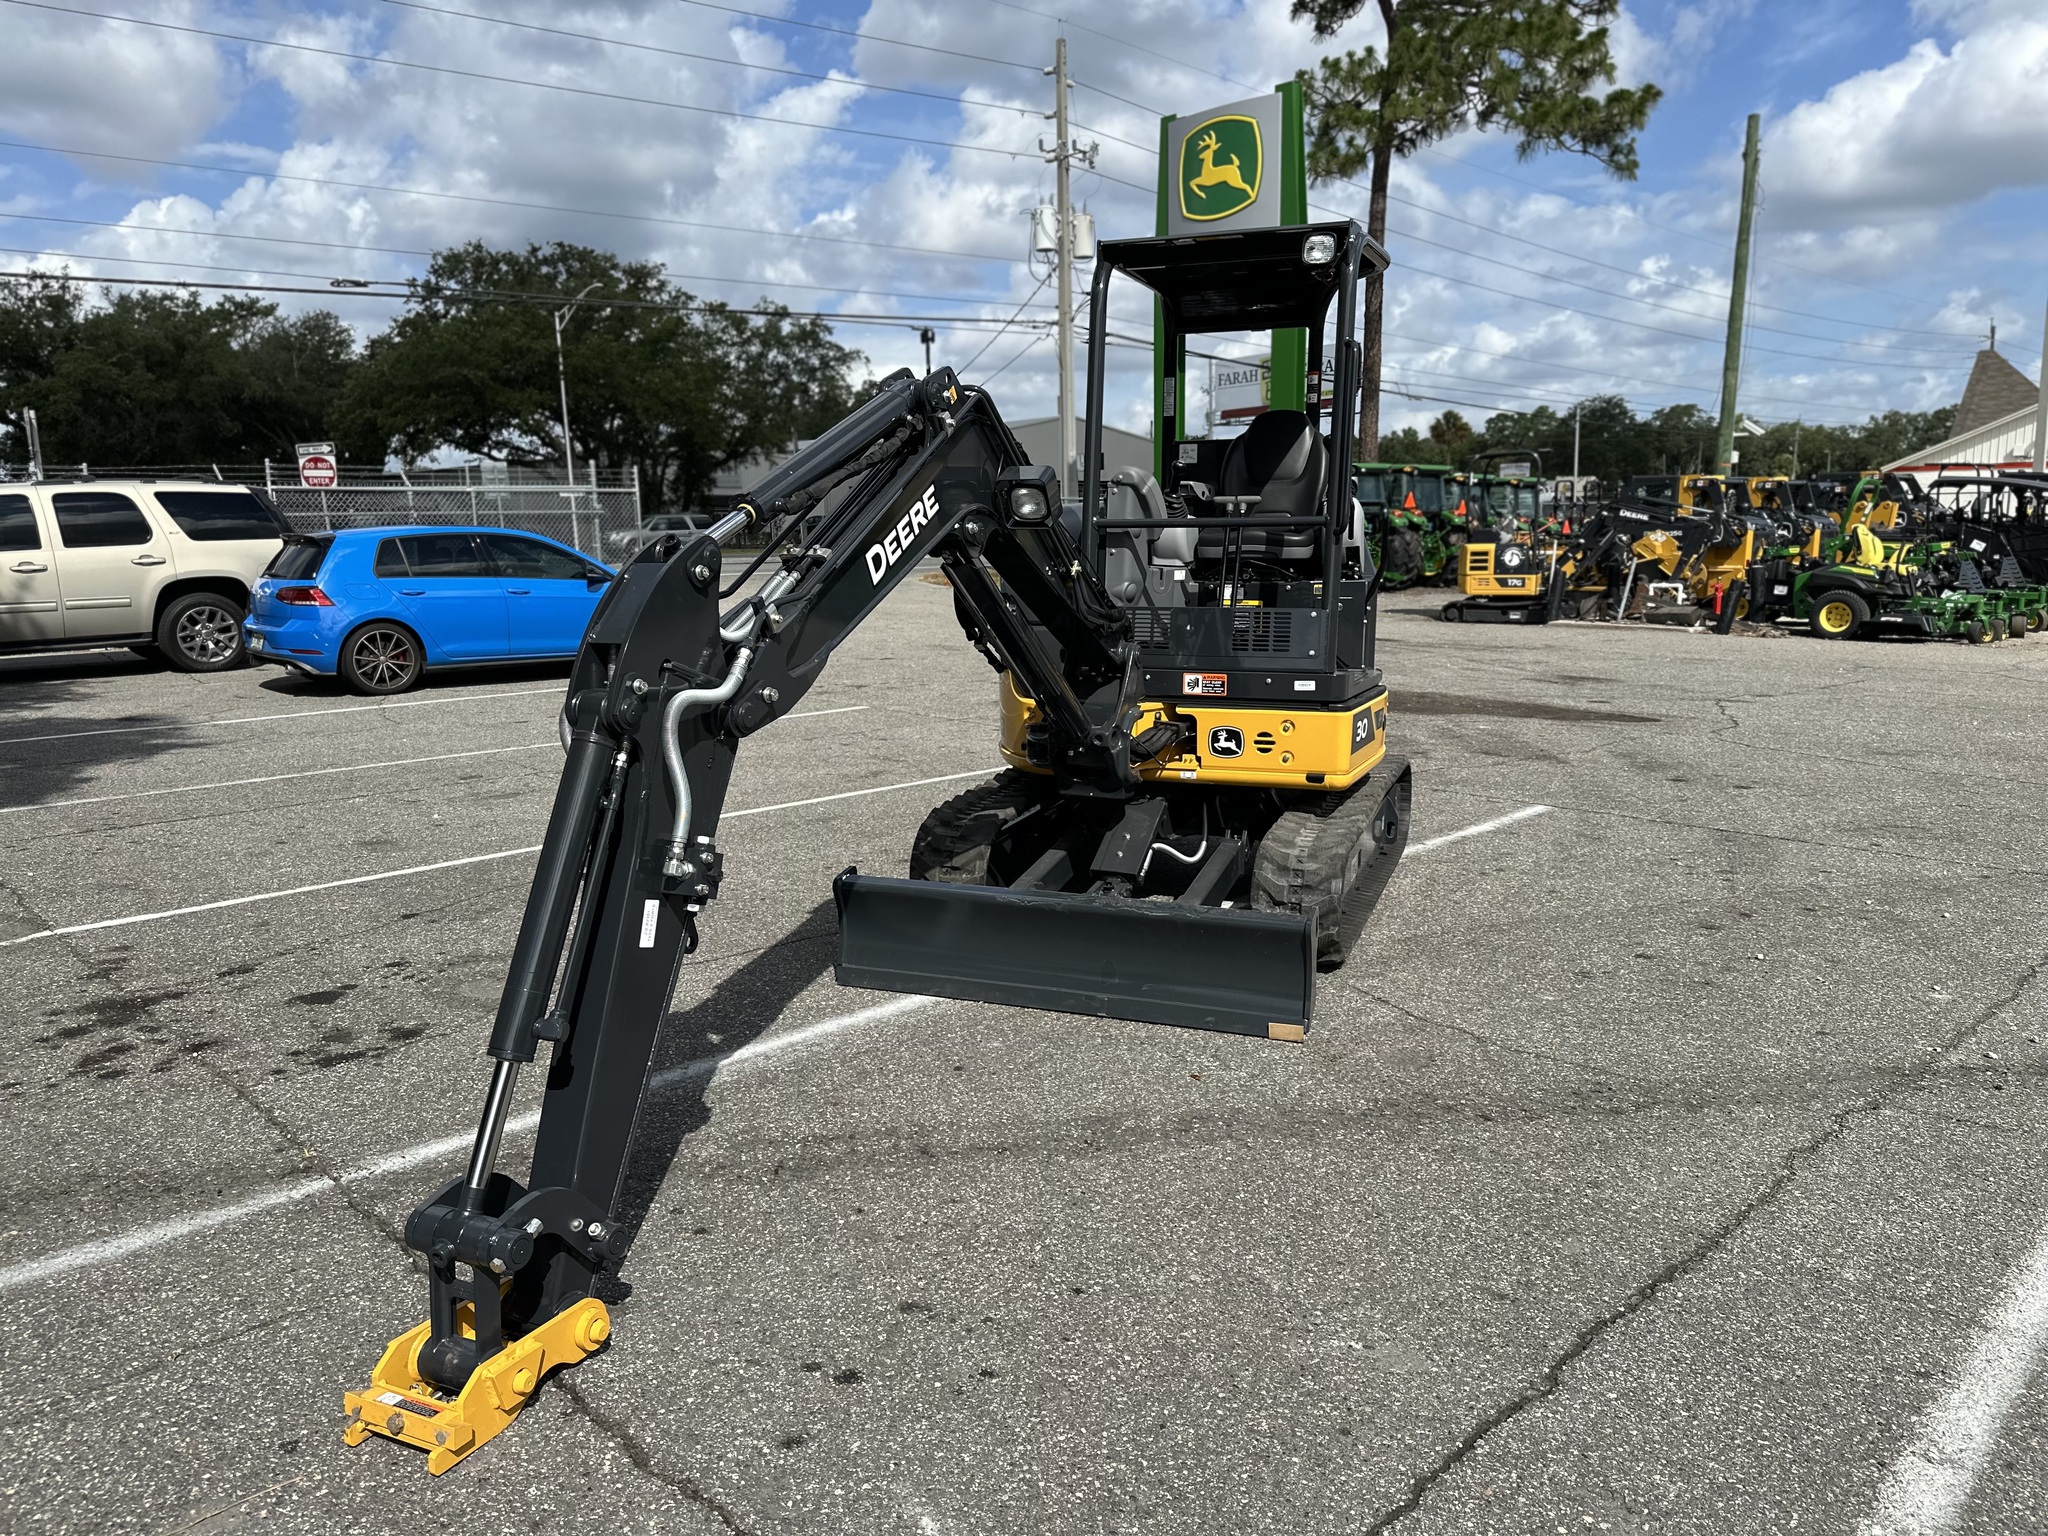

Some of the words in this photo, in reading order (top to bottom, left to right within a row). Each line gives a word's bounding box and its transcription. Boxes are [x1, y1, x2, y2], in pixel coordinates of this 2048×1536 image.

[1218, 369, 1259, 387] FARAH
[309, 477, 330, 485] ENTER
[1619, 509, 1650, 521] DEERE
[865, 484, 940, 586] DEERE
[1356, 718, 1368, 742] 30
